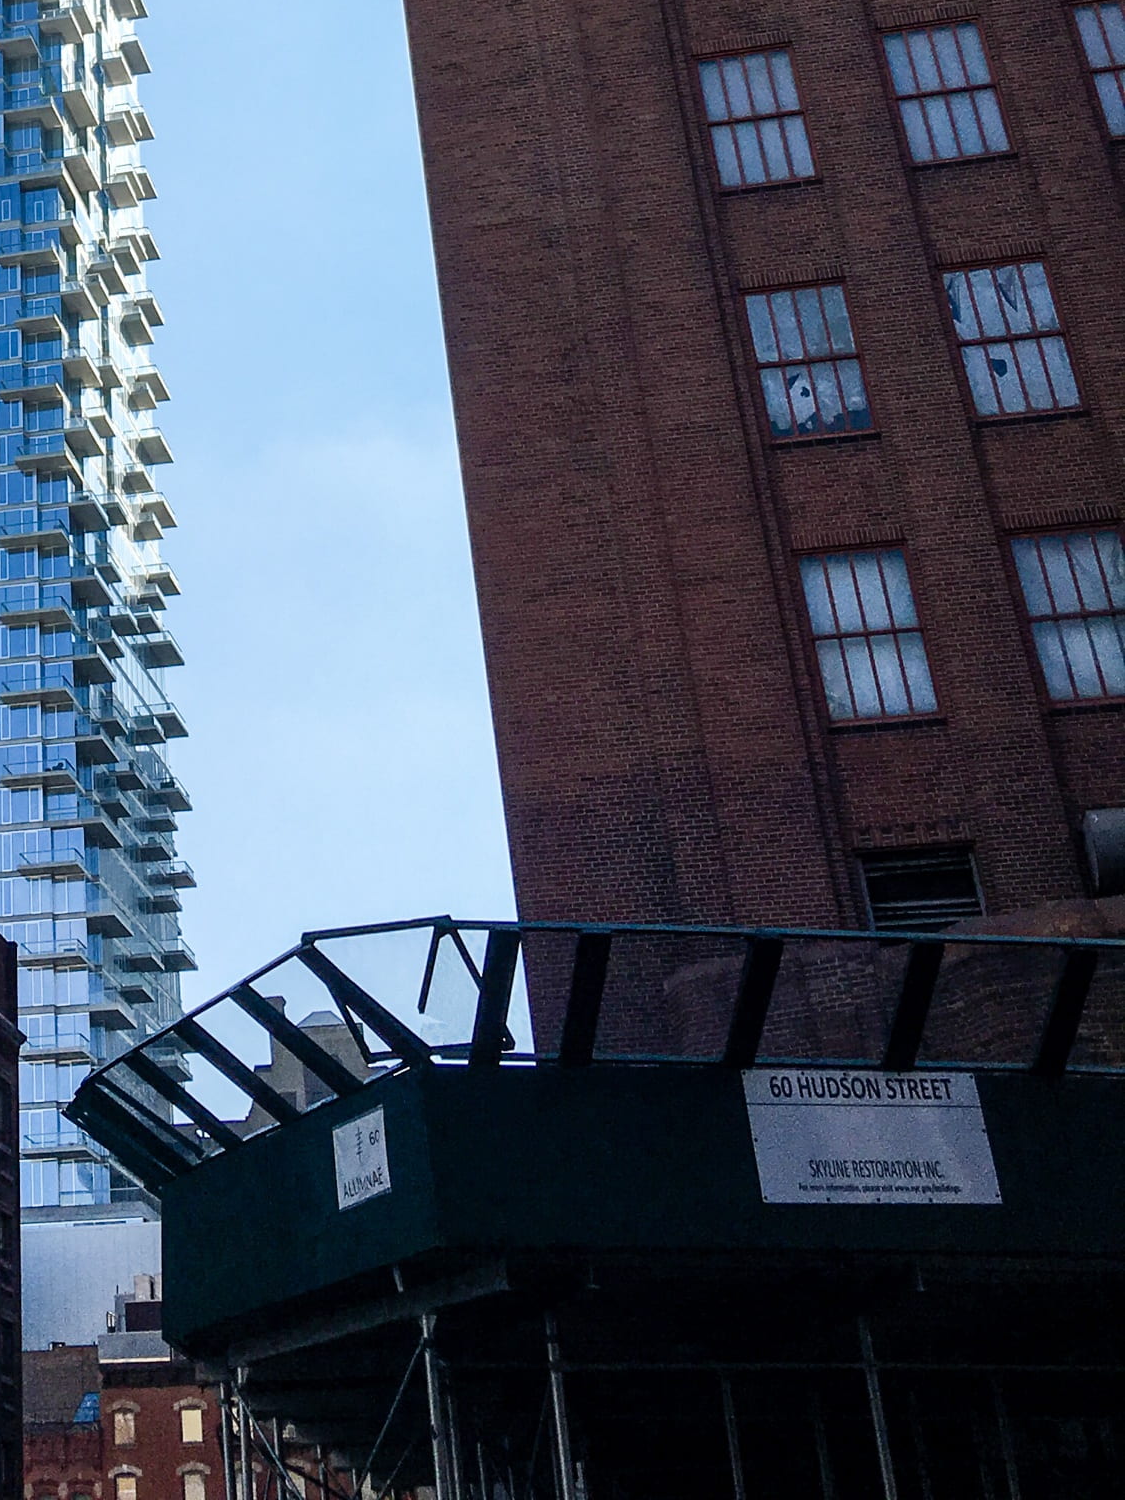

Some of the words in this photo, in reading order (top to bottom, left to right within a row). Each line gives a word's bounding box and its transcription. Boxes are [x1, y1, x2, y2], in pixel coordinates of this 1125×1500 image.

[770, 1076, 793, 1098] 60
[797, 1076, 882, 1099] HUDSON
[885, 1078, 951, 1100] STREET
[369, 1130, 380, 1145] 60
[809, 1160, 851, 1179] SKYLINE
[851, 1160, 922, 1179] RESTORATION
